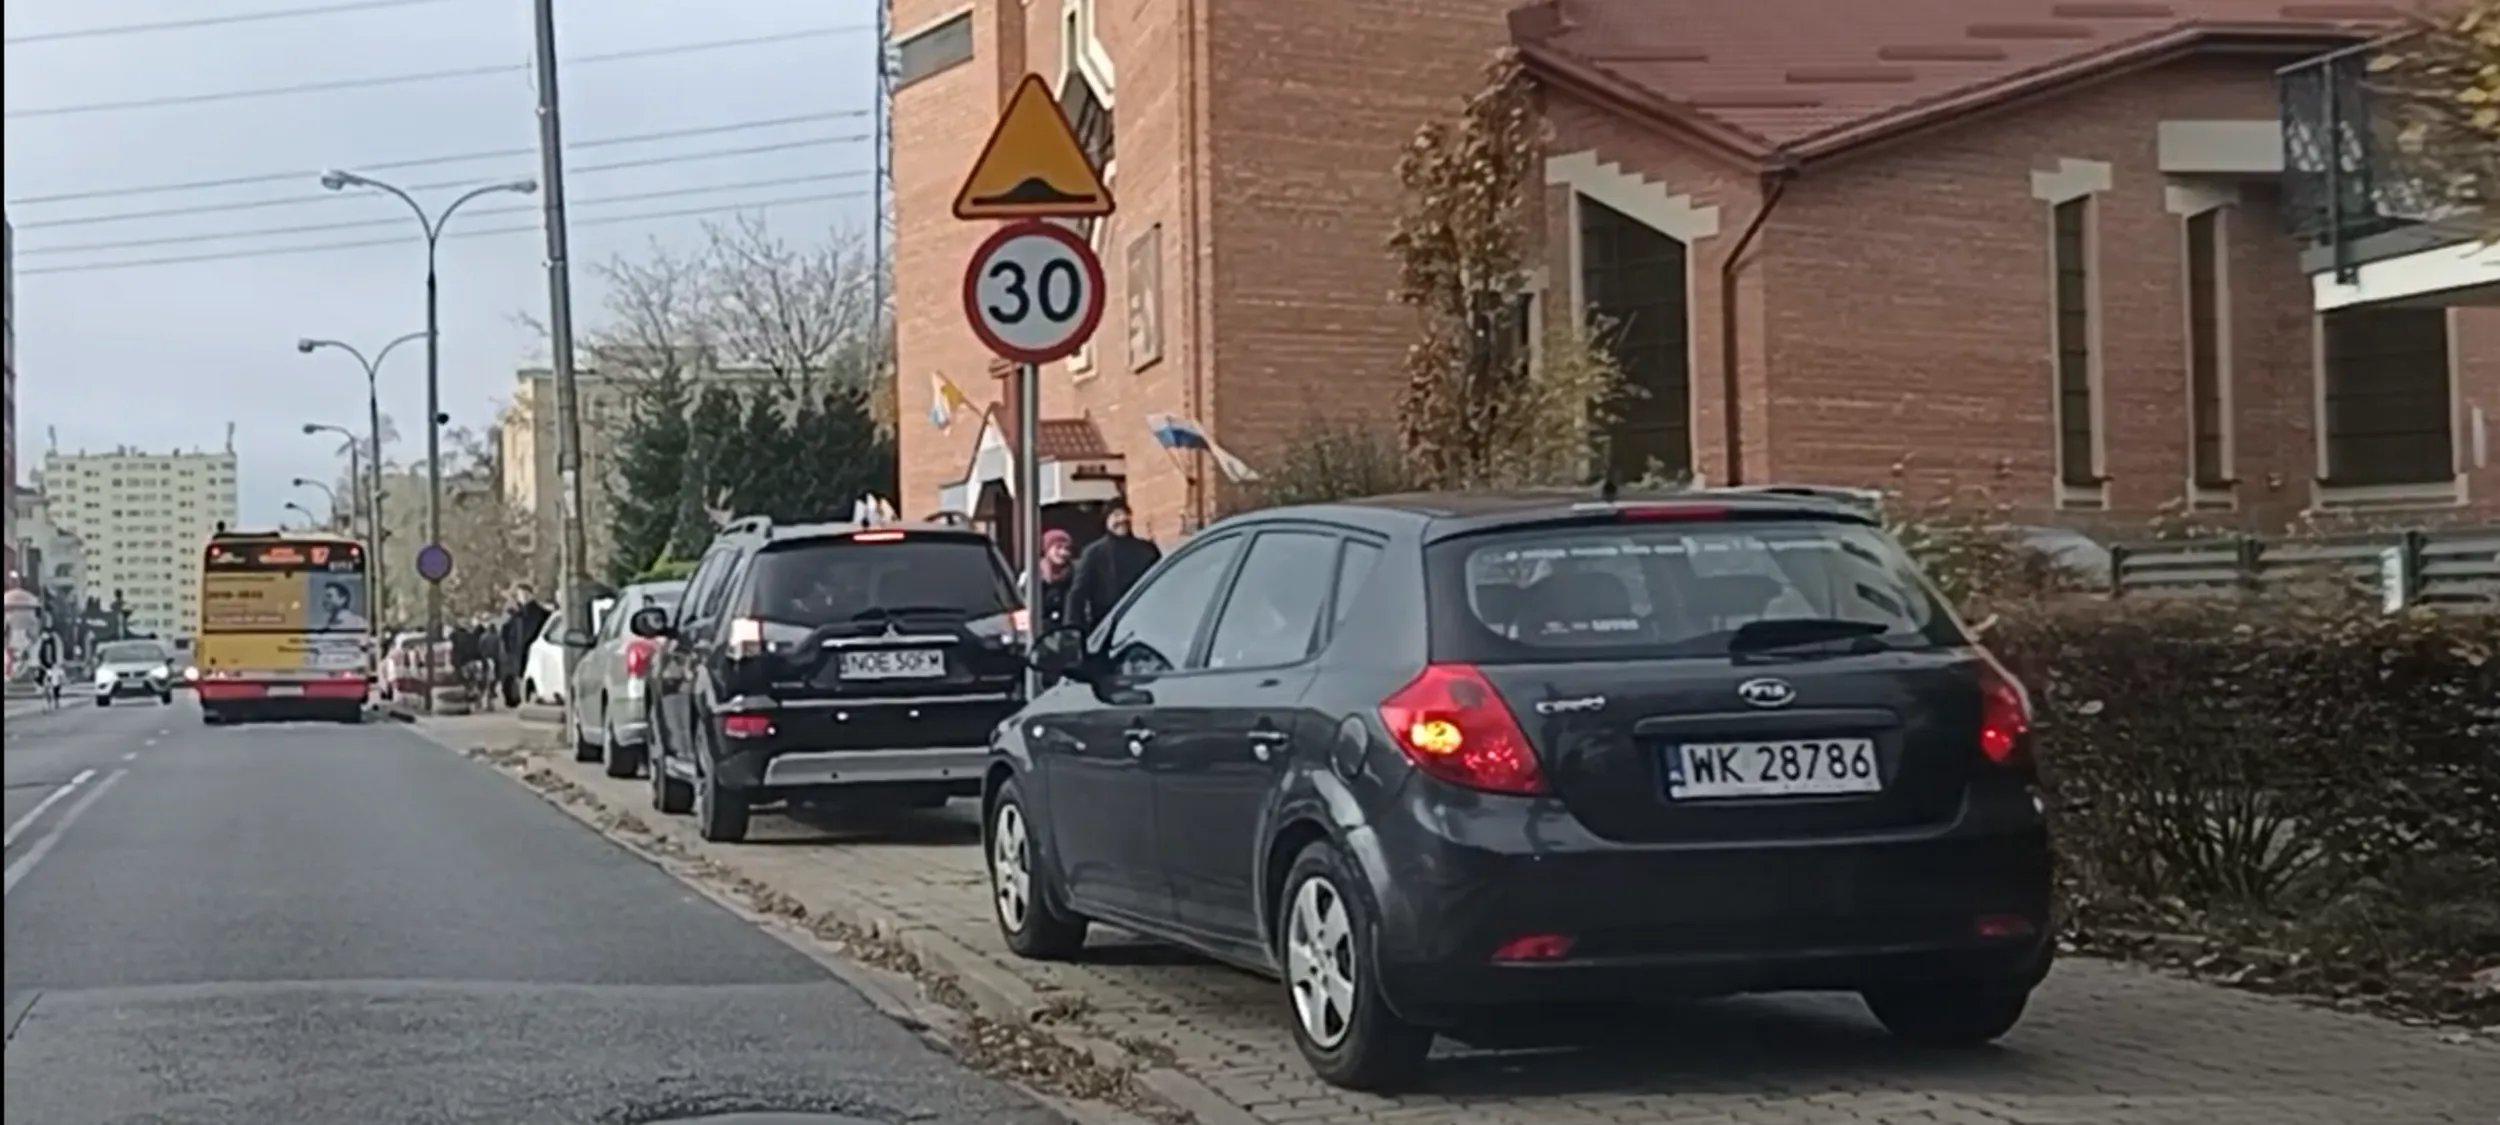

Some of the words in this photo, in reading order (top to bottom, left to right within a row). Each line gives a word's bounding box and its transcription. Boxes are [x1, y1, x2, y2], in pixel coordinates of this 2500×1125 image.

[988, 258, 1082, 324] 30
[1689, 747, 1744, 783] WK
[1757, 743, 1870, 781] 28786
